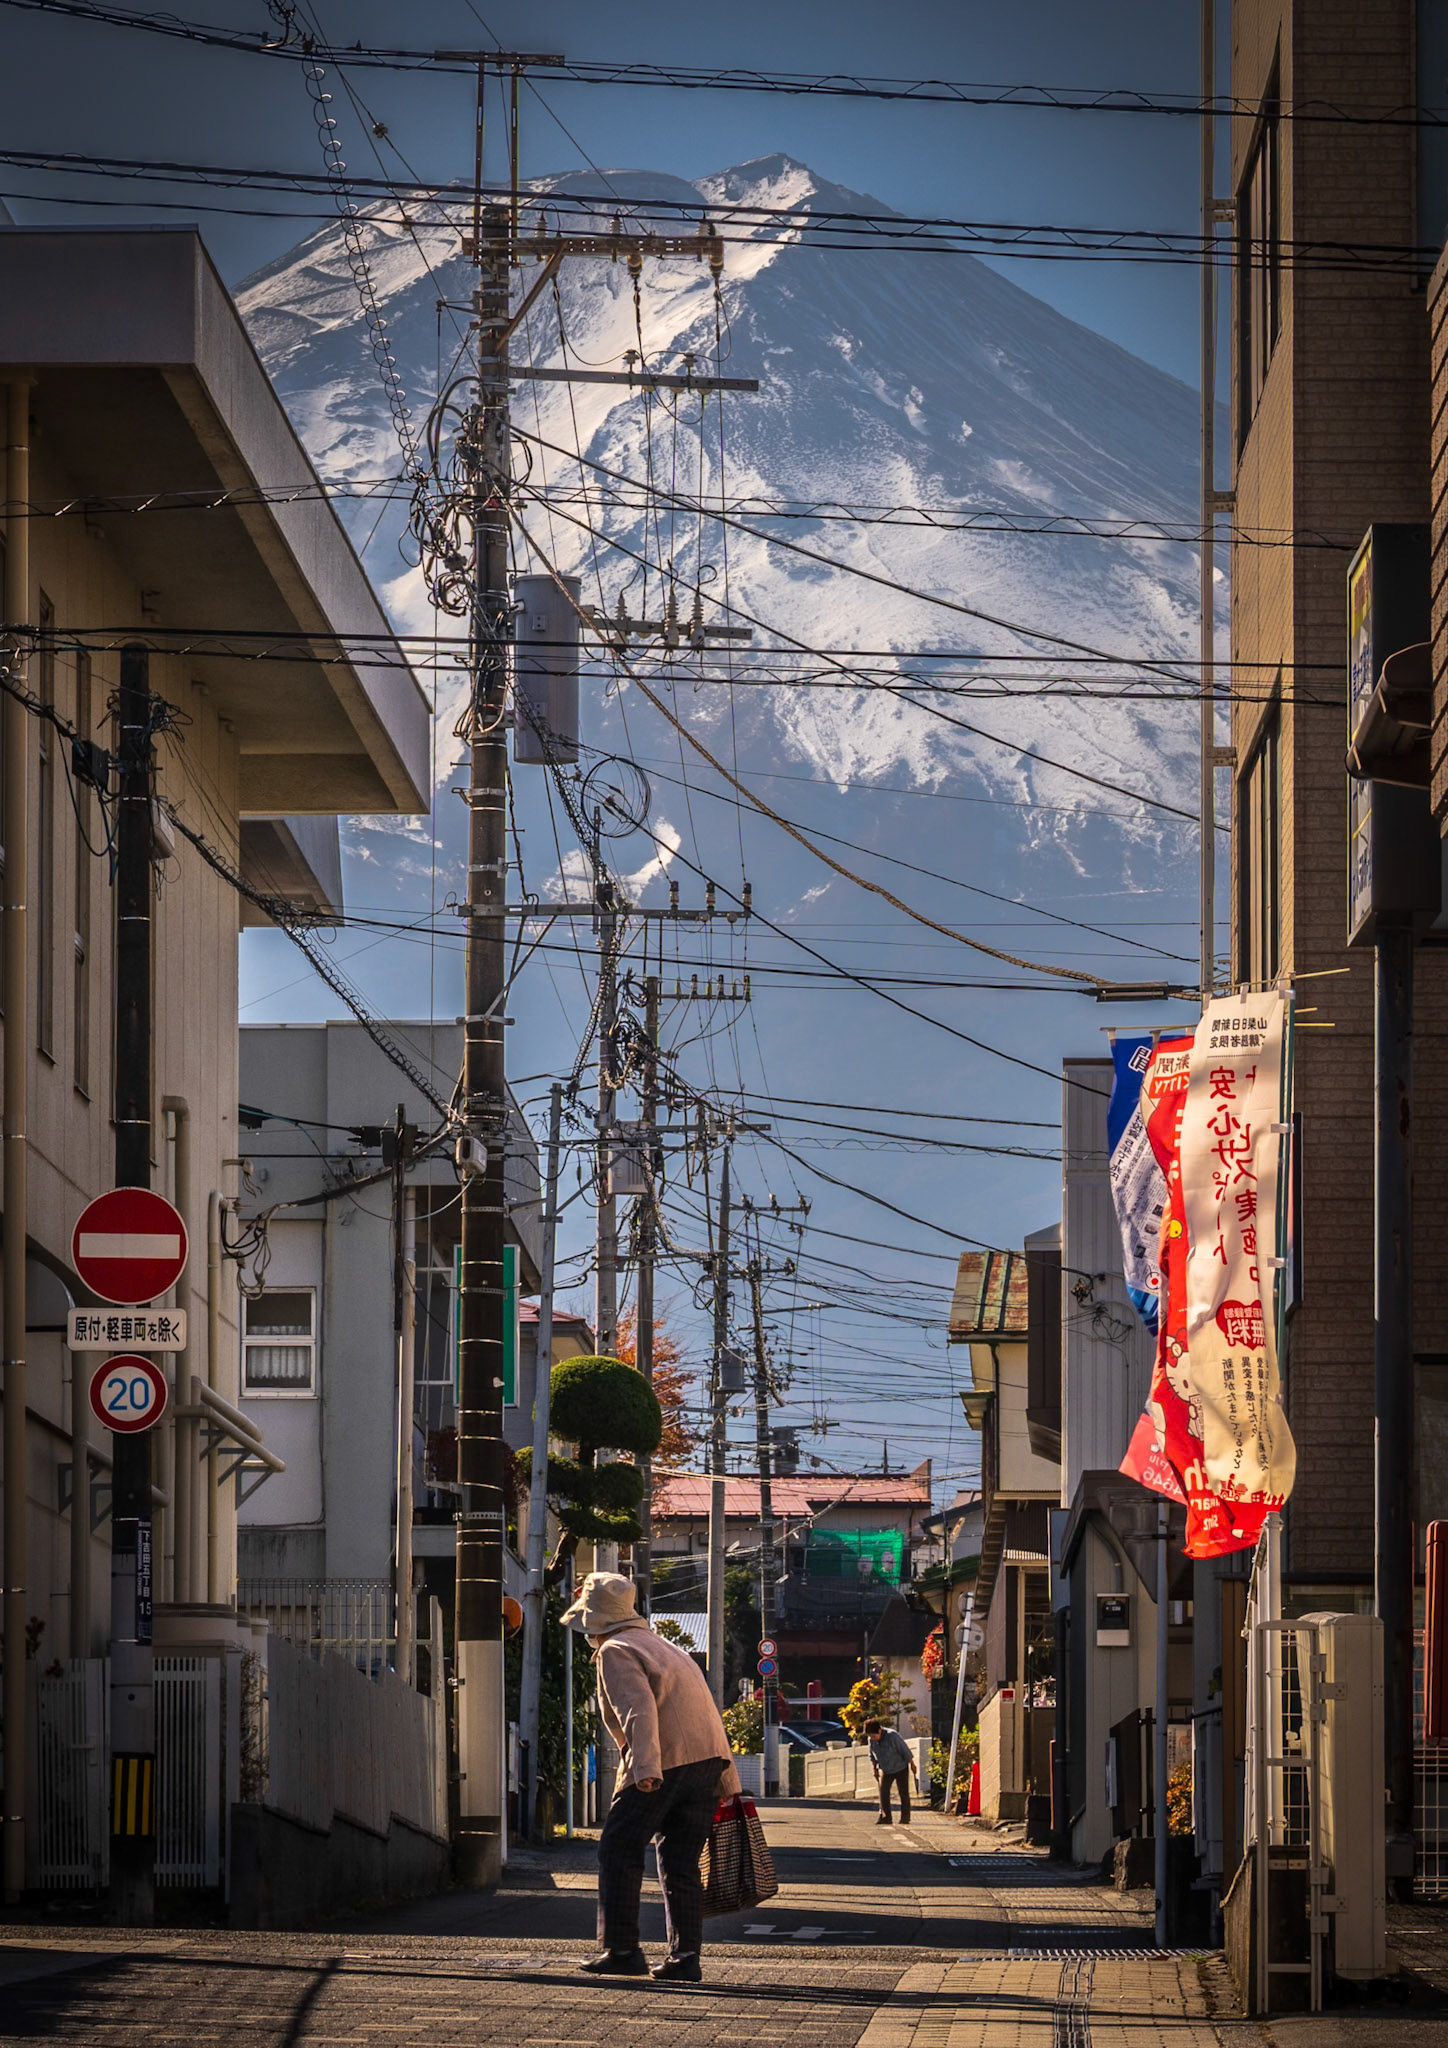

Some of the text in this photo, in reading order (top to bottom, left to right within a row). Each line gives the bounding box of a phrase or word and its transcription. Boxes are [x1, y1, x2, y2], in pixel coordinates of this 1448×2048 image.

[75, 1316, 180, 1342] 原付・軽車両を除く
[108, 1377, 149, 1411] 20
[139, 1602, 152, 1615] 15
[762, 1644, 773, 1653] 20
